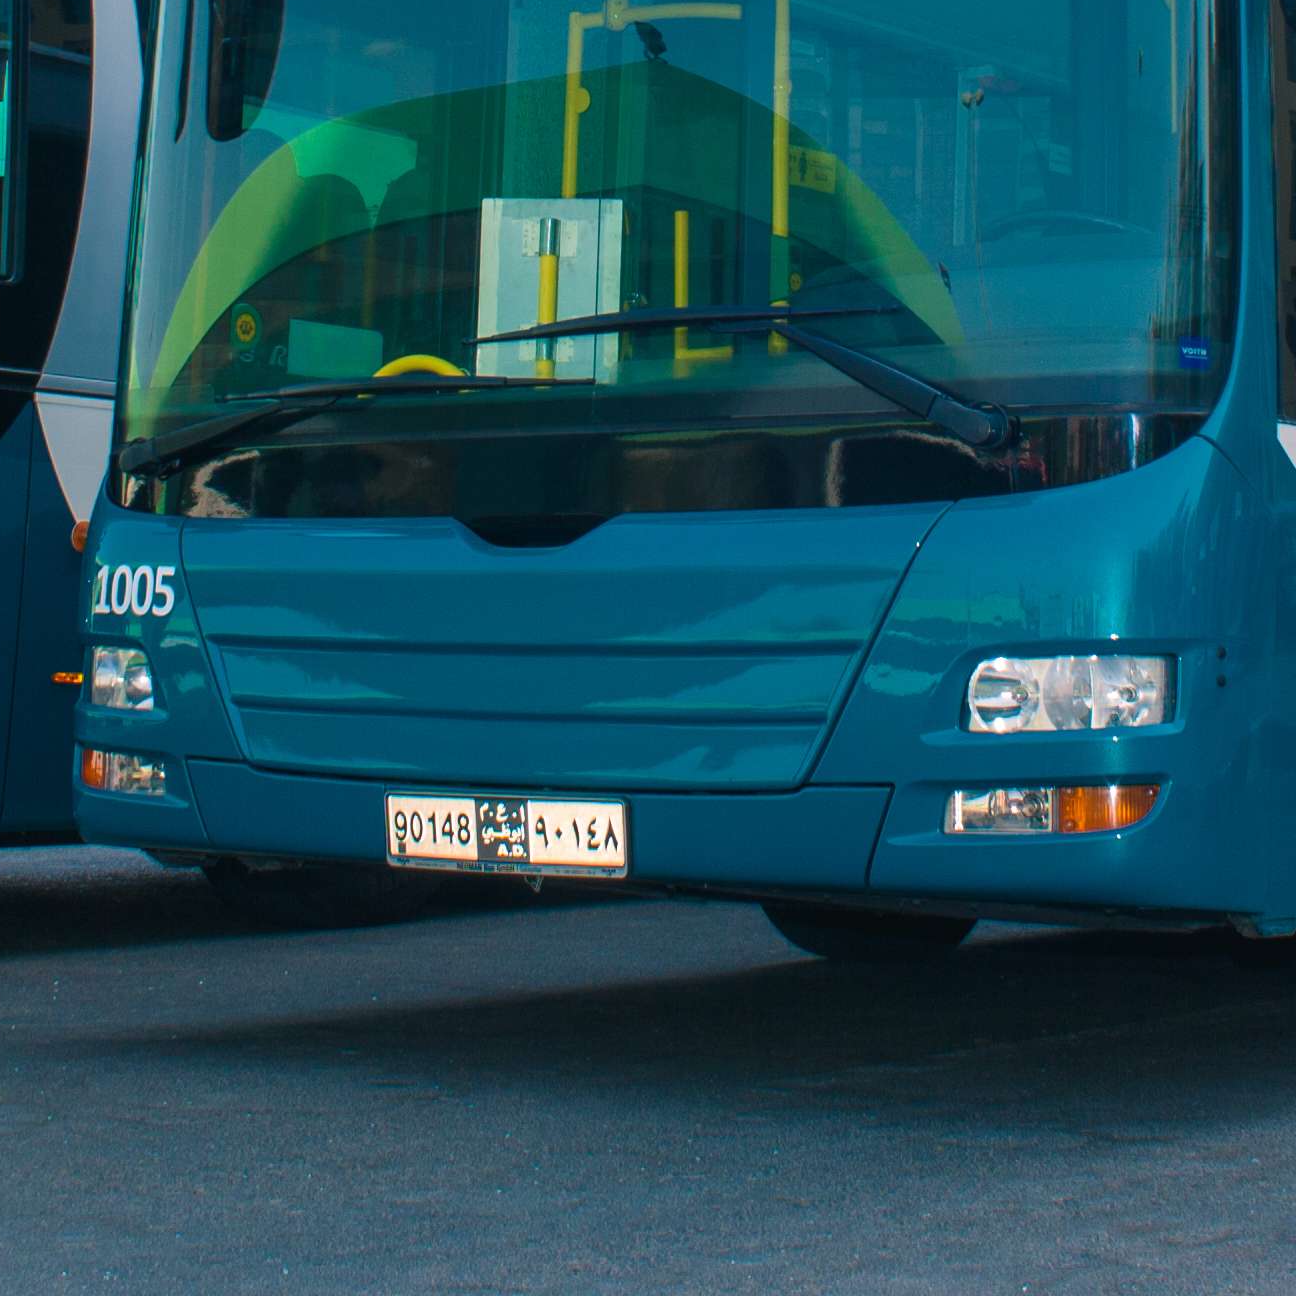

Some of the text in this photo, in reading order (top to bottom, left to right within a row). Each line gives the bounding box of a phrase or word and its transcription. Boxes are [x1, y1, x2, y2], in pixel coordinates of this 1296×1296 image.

[93, 564, 176, 616] 1005
[394, 810, 472, 845] 90148
[497, 843, 528, 858] A.D.
